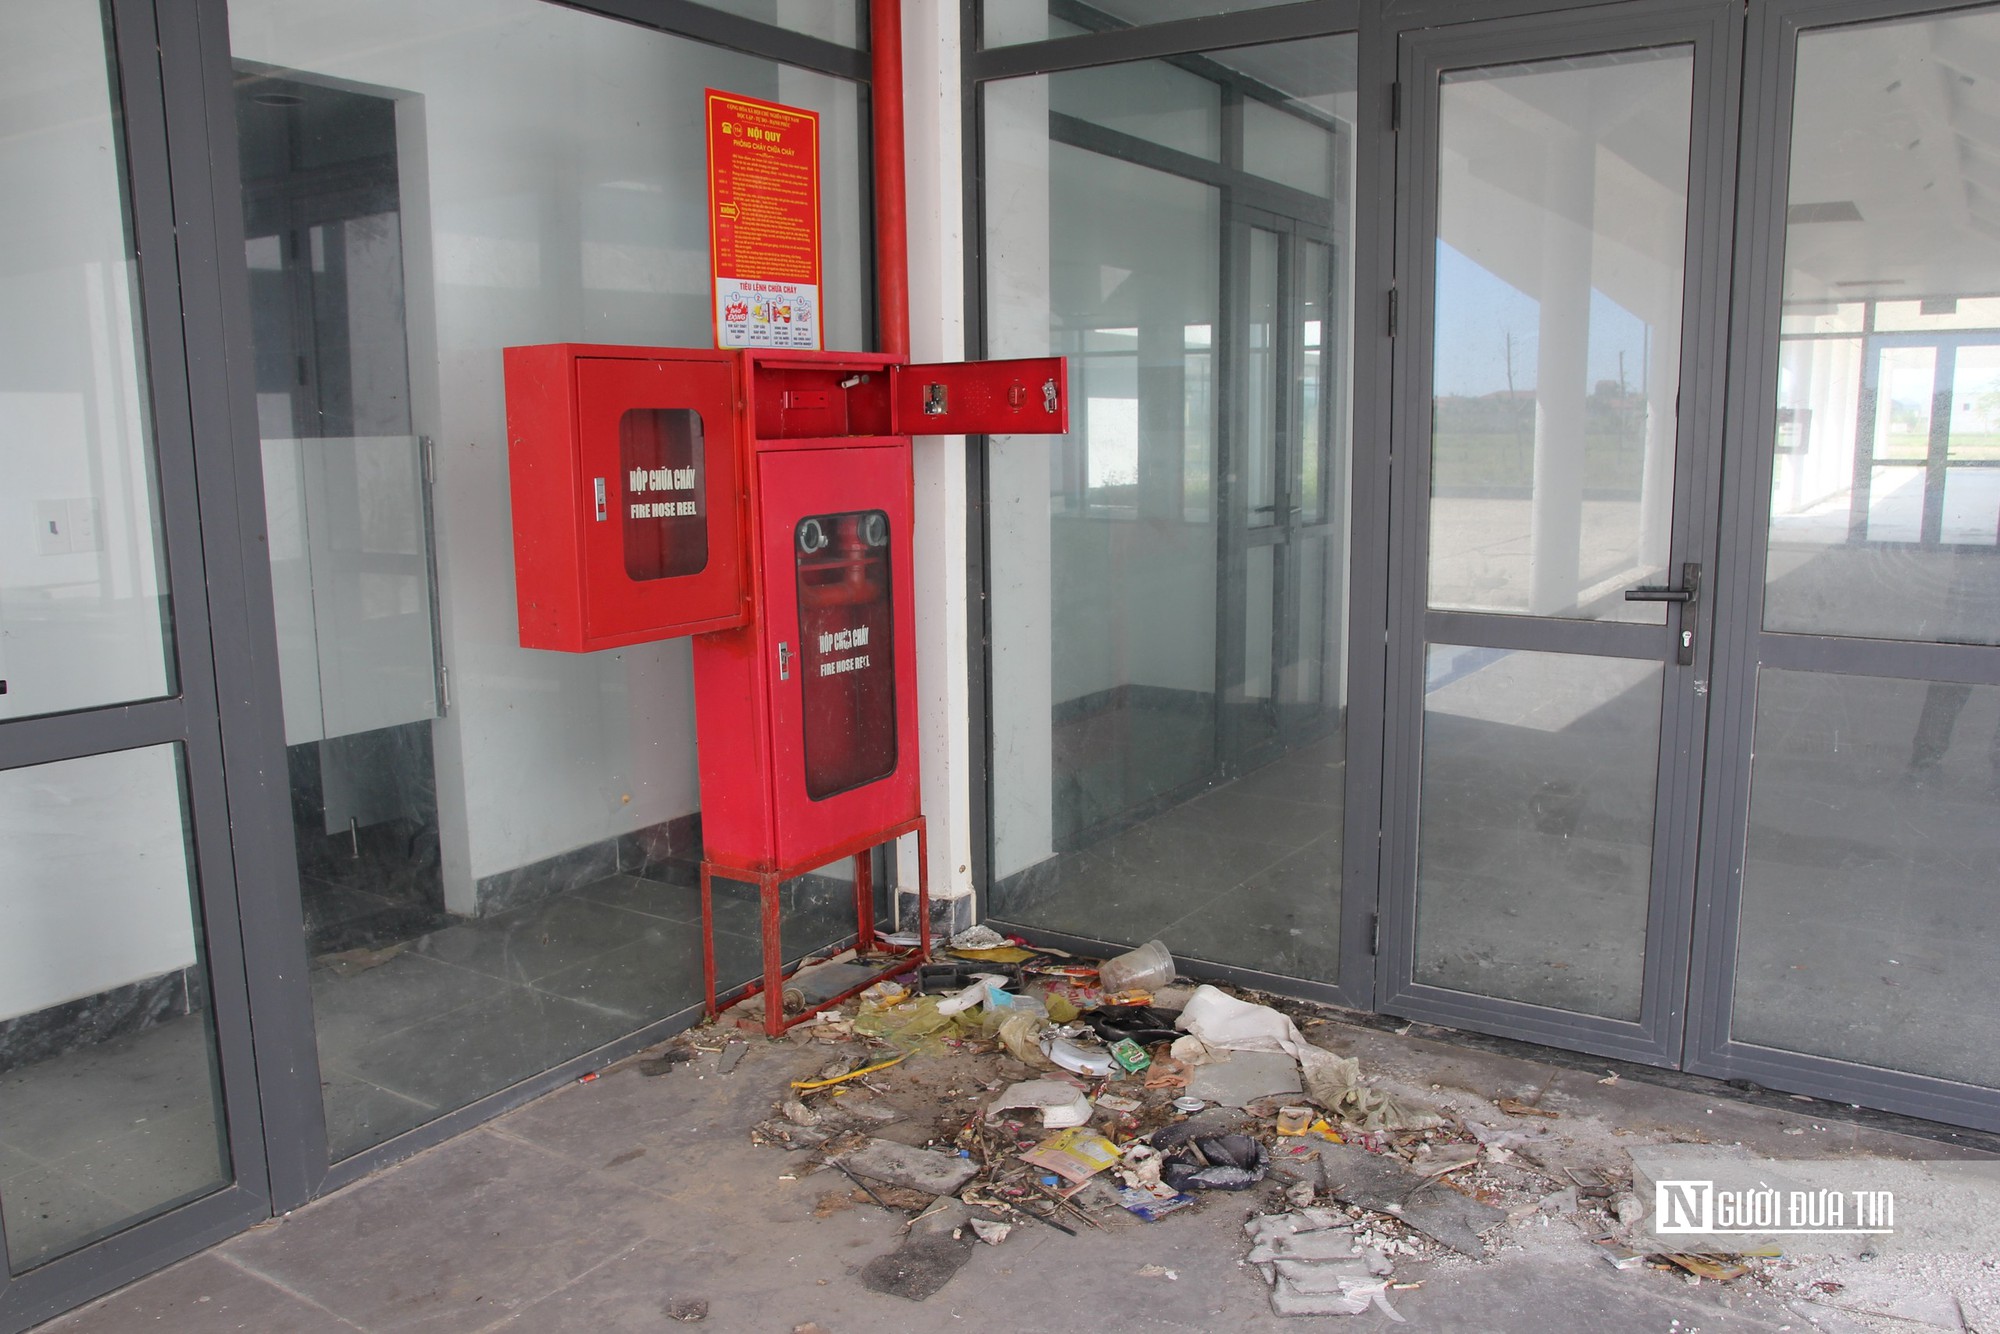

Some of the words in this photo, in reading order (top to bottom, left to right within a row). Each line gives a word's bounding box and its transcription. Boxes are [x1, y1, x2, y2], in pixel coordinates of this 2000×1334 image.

[747, 127, 762, 140] NỘI
[764, 130, 781, 142] QUY
[733, 139, 751, 148] PHÒNG
[752, 142, 766, 151] CHÁY
[767, 145, 780, 153] CHỮA
[781, 147, 794, 156] CHÁY
[753, 282, 767, 292] LỆNH
[630, 466, 648, 495] HỘP
[649, 466, 673, 491] CHỮA
[674, 465, 696, 490] CHÁY
[631, 504, 651, 519] FIRE
[652, 502, 676, 518] HOSE
[677, 501, 697, 516] REEL
[819, 631, 833, 655] HỘP
[852, 624, 869, 647] CHÁY
[820, 662, 835, 677] FIRE
[836, 658, 854, 673] HOSE
